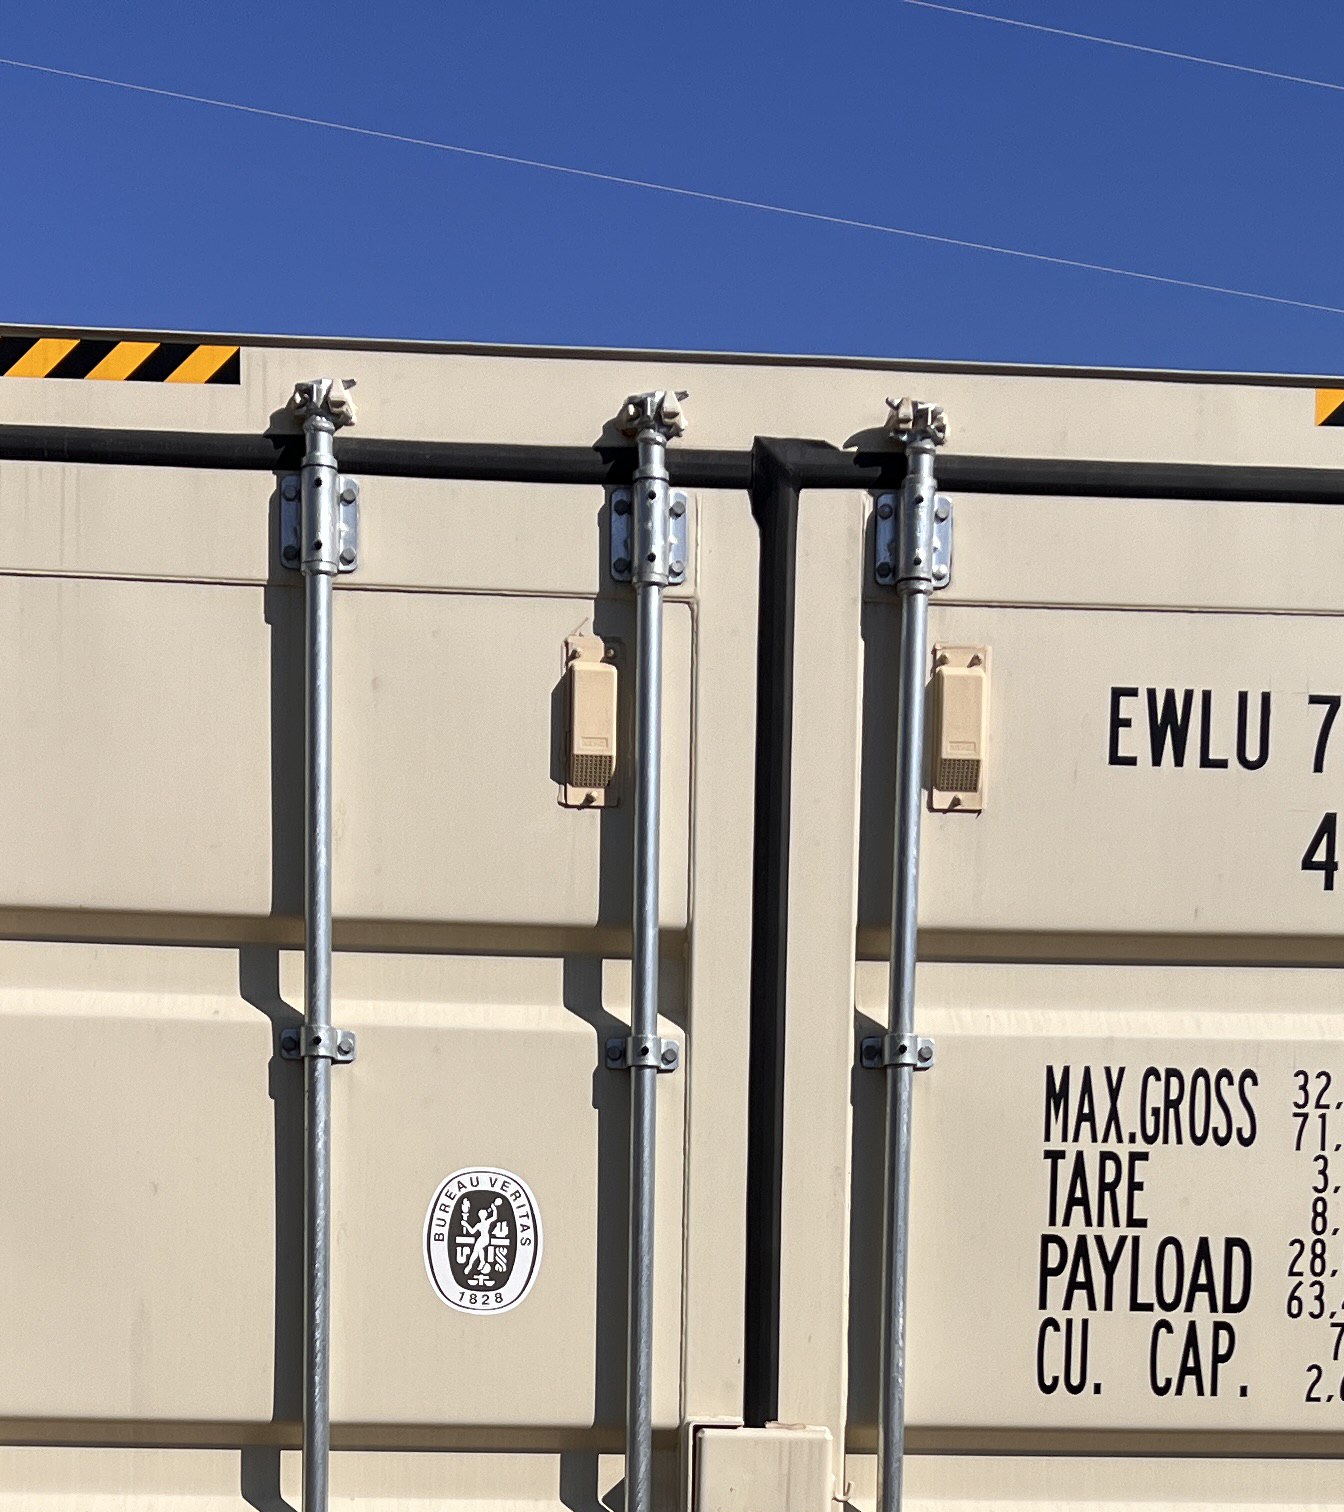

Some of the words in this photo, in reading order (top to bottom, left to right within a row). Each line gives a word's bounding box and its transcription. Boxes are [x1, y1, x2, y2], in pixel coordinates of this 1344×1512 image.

[1109, 687, 1270, 770] EWLU
[1044, 1065, 1258, 1147] MAX.GROSS
[434, 1176, 479, 1241] BUREAU
[489, 1177, 531, 1247] VERITAS
[1044, 1150, 1149, 1228] TARE
[458, 1291, 503, 1305] 1828
[1039, 1234, 1251, 1313] PAYLOAD
[1037, 1317, 1101, 1395] CU.
[1150, 1319, 1247, 1397] CAP.
